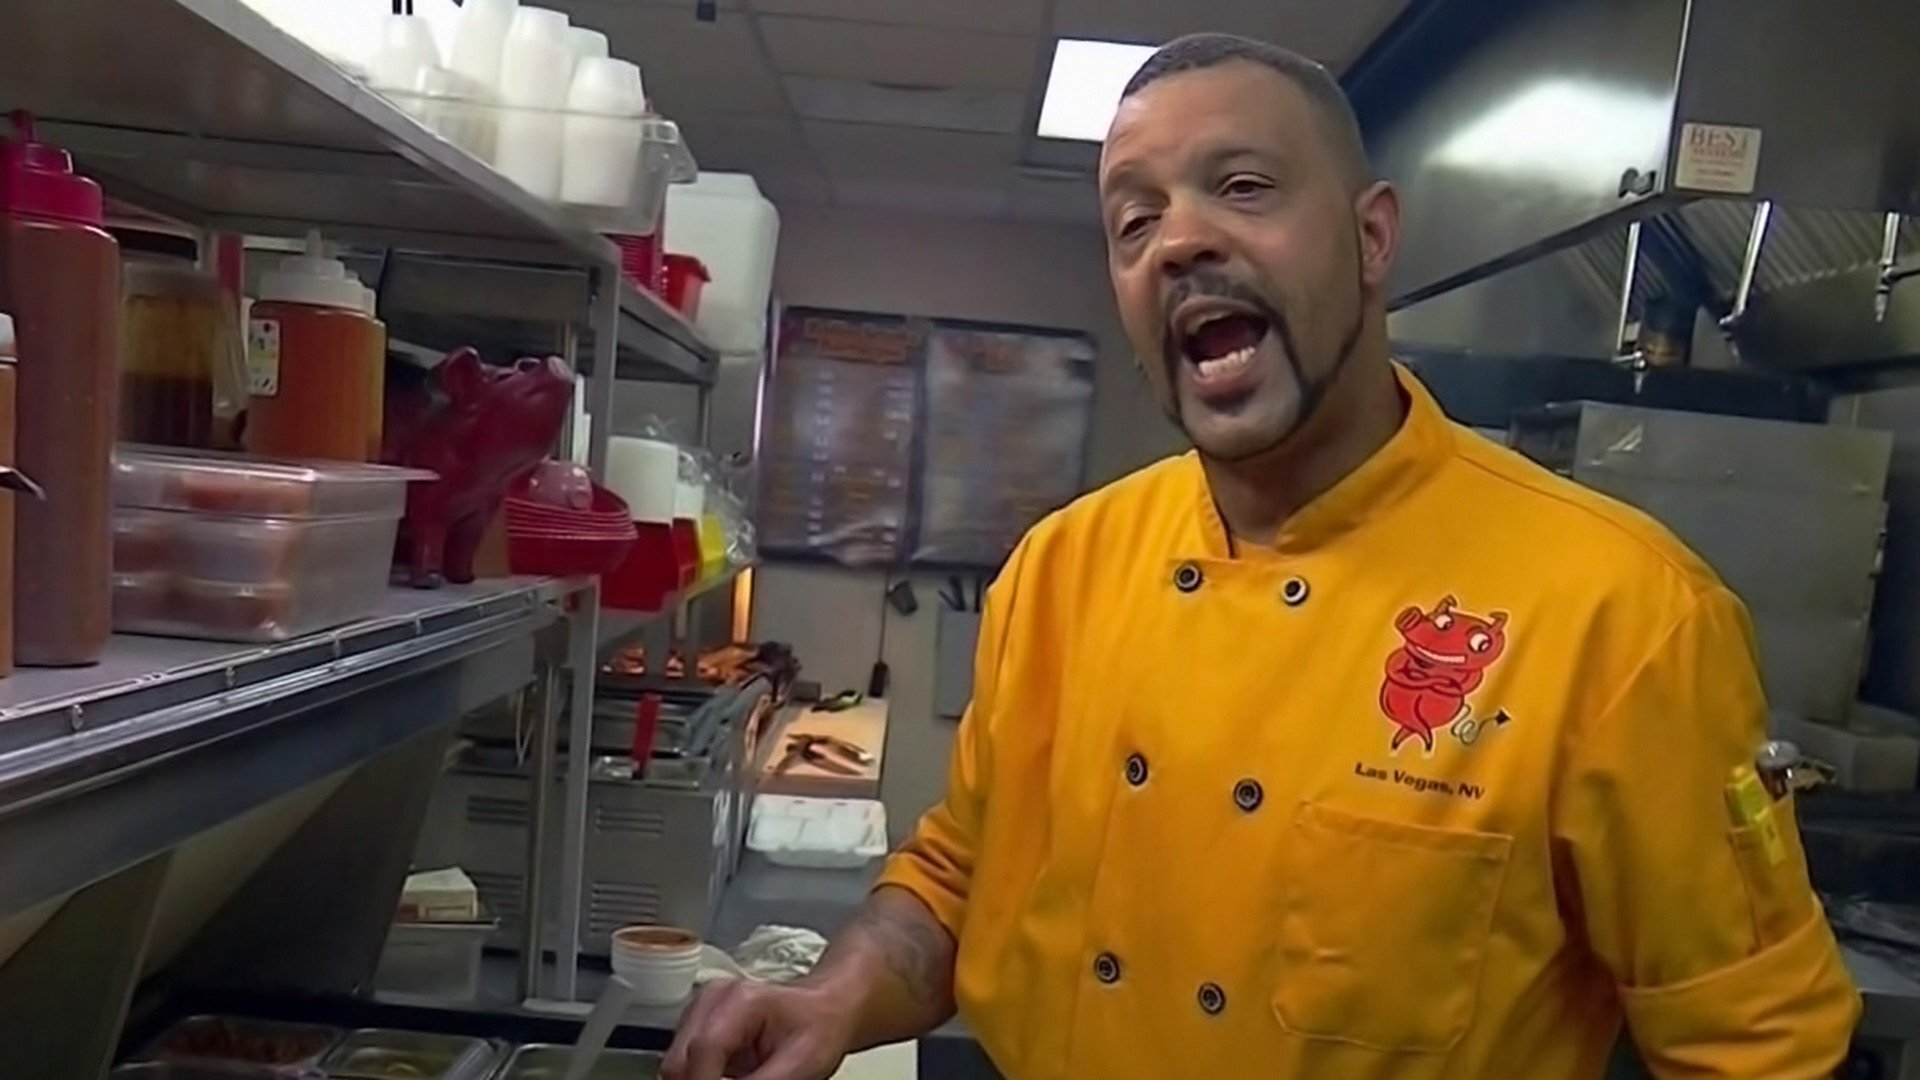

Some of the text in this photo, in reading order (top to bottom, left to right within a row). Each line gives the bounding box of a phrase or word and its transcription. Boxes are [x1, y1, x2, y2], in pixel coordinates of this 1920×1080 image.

[1354, 761, 1486, 799] Las Vegas, NV
